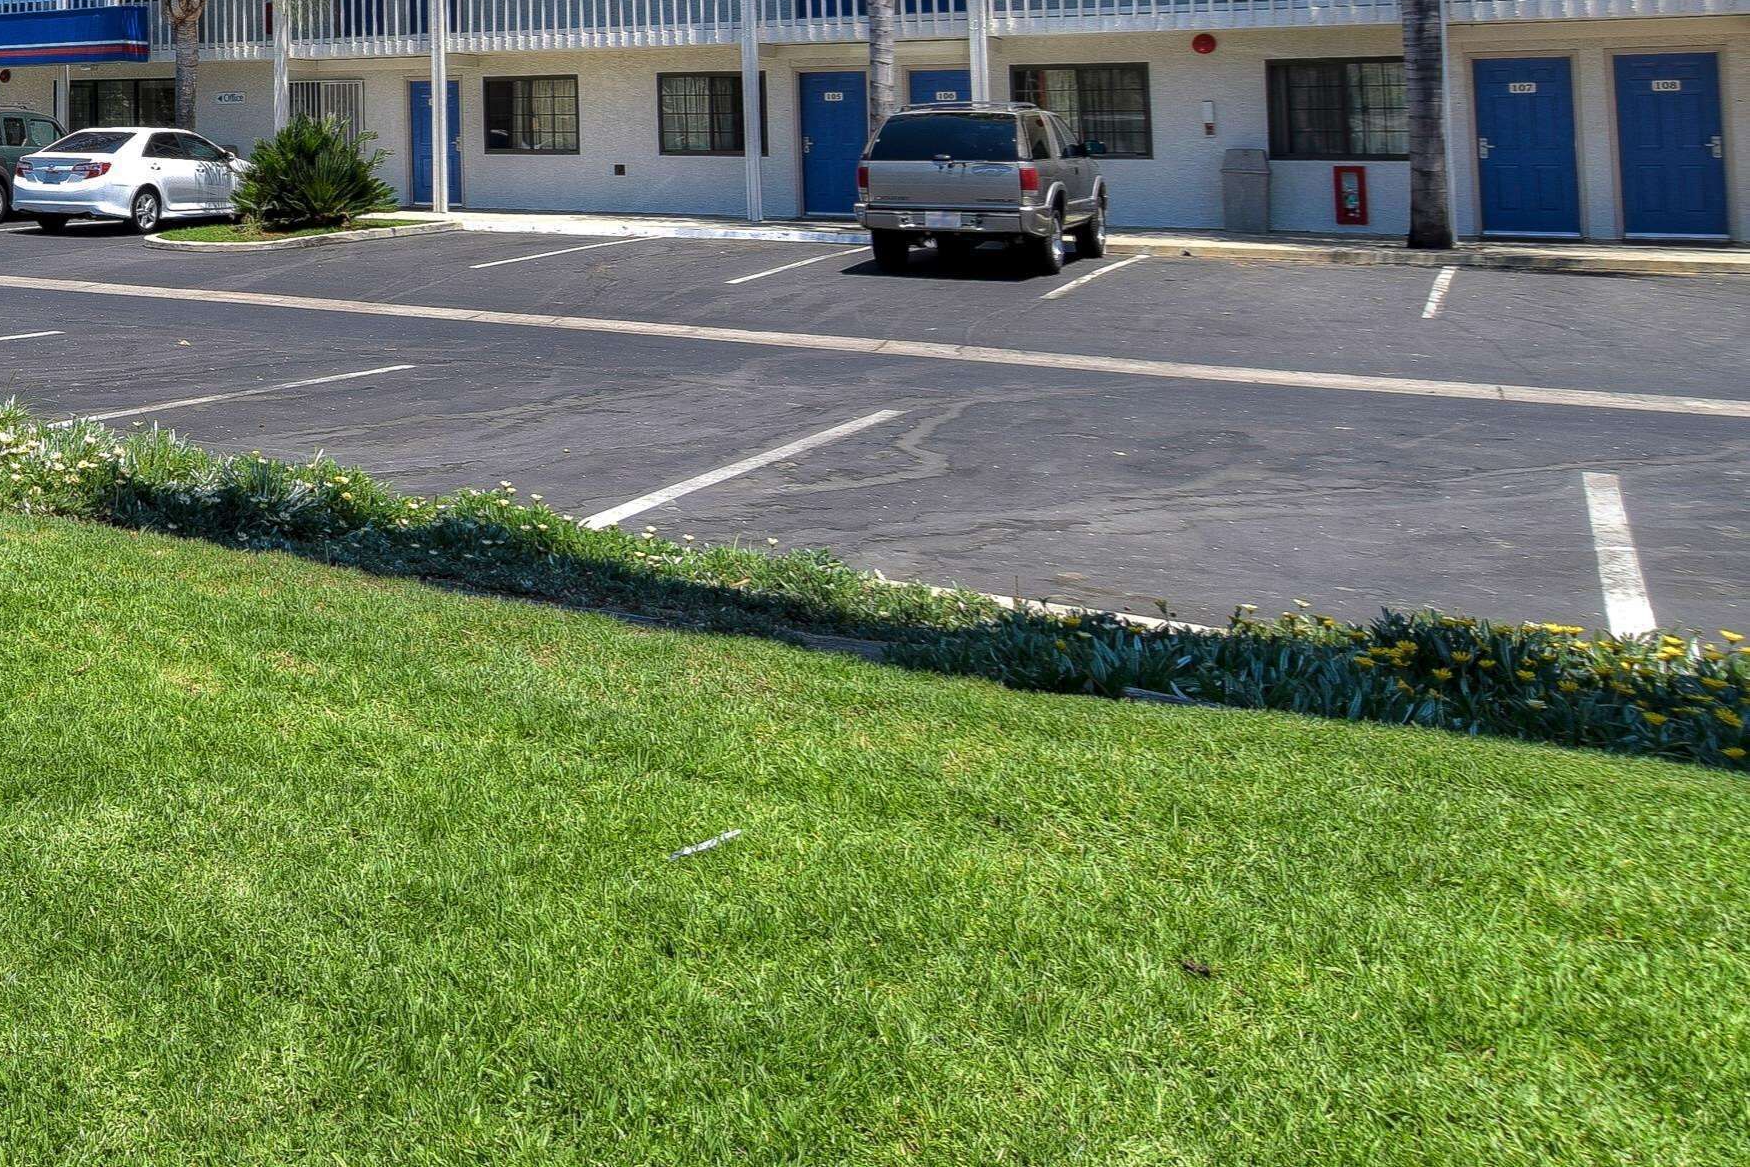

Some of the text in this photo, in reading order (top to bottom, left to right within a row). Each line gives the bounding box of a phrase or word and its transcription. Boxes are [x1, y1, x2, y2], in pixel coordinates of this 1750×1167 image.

[1512, 84, 1532, 92] 107
[1655, 81, 1677, 90] 108
[224, 93, 243, 102] Office
